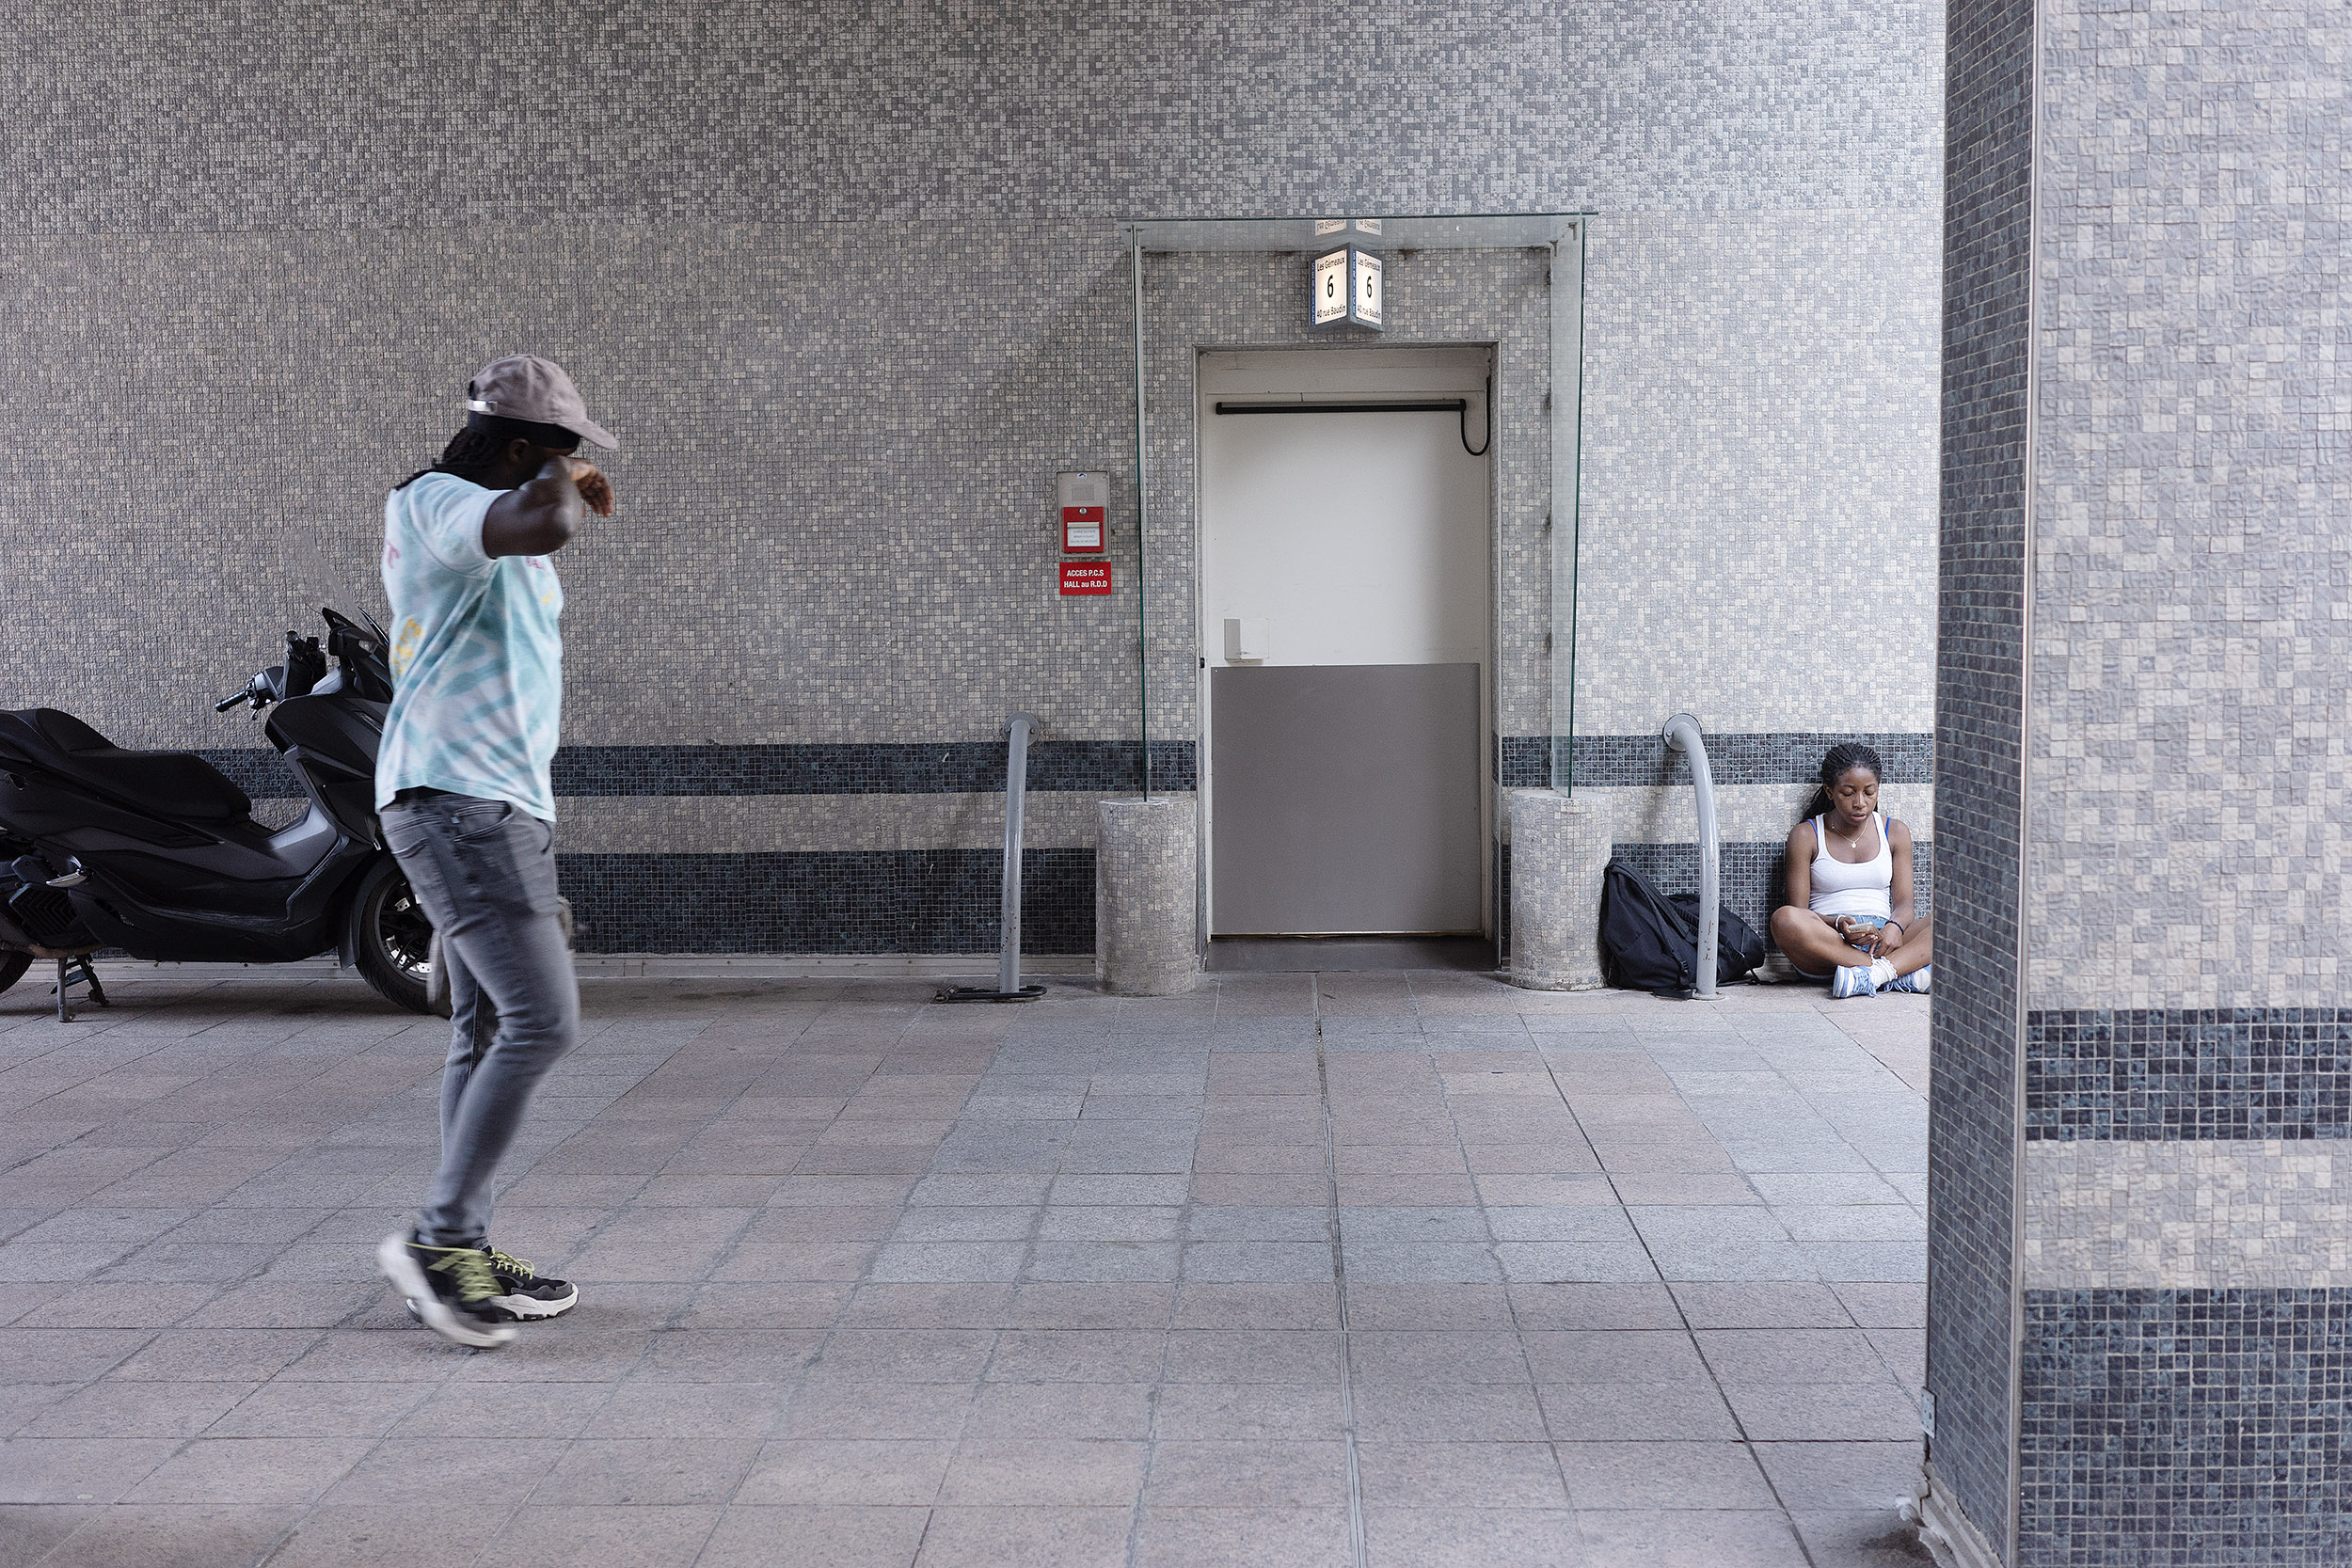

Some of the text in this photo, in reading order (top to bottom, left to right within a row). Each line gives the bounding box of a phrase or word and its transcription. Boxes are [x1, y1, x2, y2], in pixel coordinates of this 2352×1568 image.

[1325, 257, 1345, 270] Gémeaux
[1364, 259, 1381, 272] Gémeaux
[1327, 274, 1334, 298] 6
[1366, 276, 1373, 298] 6
[1317, 309, 1323, 319] 40
[1331, 304, 1346, 315] Baudin
[1358, 305, 1362, 313] 40
[1369, 308, 1381, 319] Baudin
